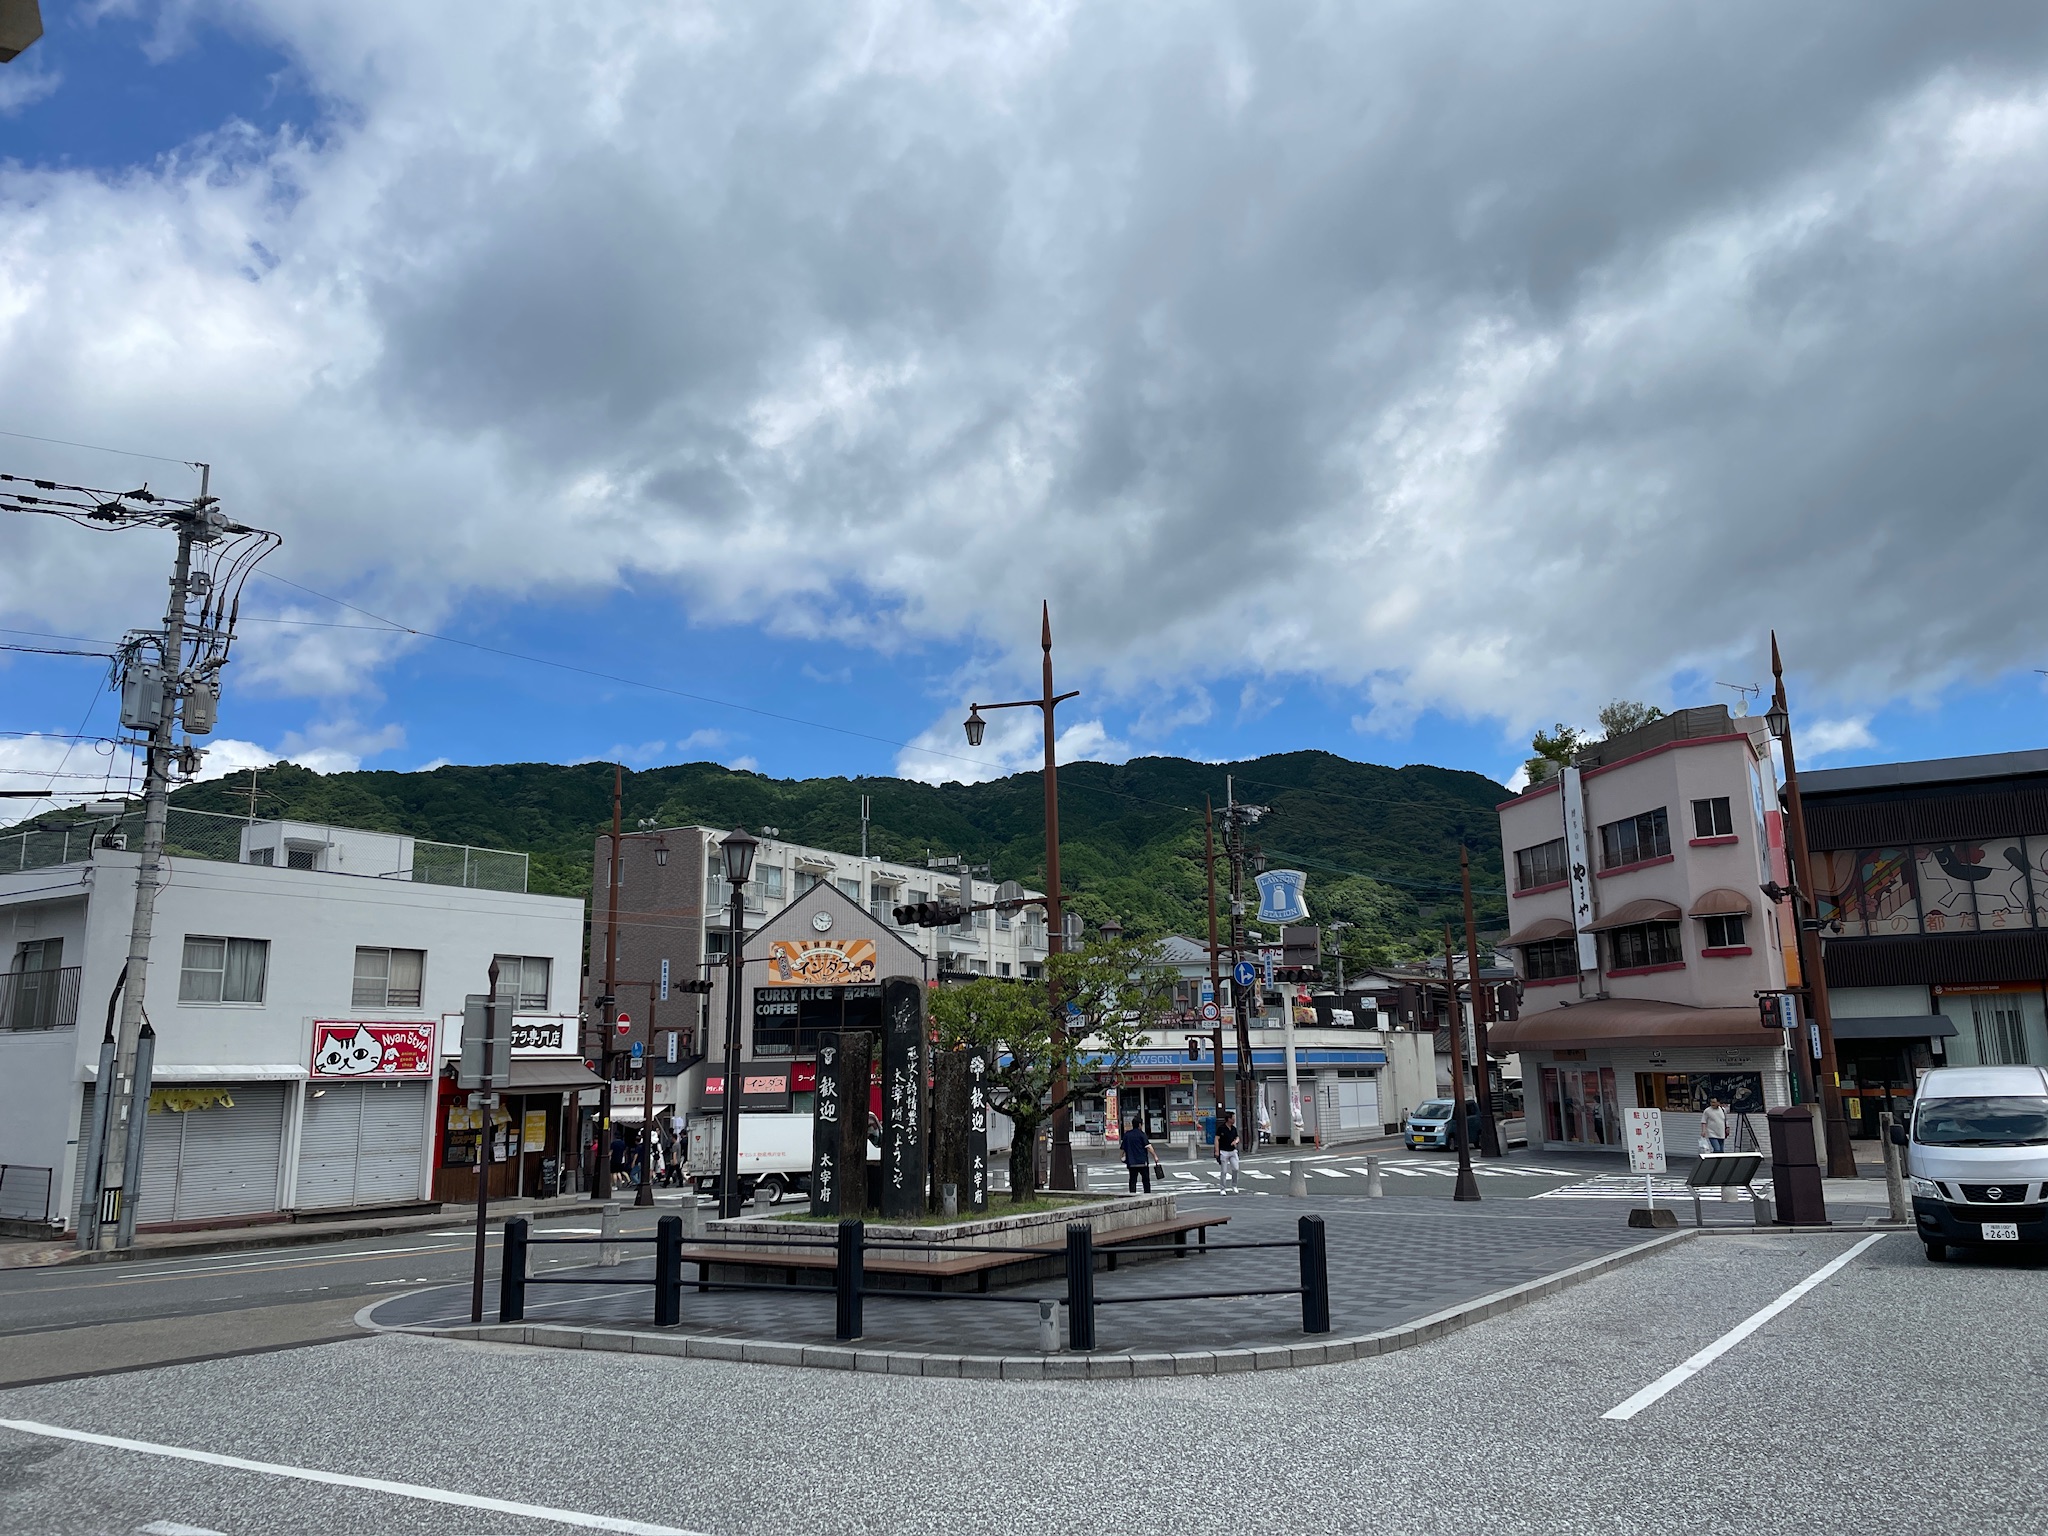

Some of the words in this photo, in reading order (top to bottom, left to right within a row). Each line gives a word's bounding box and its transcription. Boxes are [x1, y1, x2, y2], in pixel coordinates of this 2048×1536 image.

[1260, 875, 1297, 886] LAWSON
[1573, 861, 1589, 918] やまや
[1262, 907, 1298, 918] STATION
[792, 957, 851, 977] インダス
[757, 989, 797, 1002] CURRY
[801, 988, 833, 1000] RICE
[756, 1003, 798, 1015] COFFEE
[1205, 1007, 1216, 1016] 30
[381, 1033, 406, 1046] Nyan
[407, 1031, 428, 1053] Style
[746, 1077, 783, 1087] インダス
[818, 1075, 839, 1123] 歓迎
[969, 1086, 986, 1133] 歓迎
[1633, 1111, 1646, 1170] 駐車禁止
[1642, 1111, 1656, 1170] Uターン禁止
[1651, 1111, 1663, 1161] ロータリー内
[819, 1152, 834, 1203] 太宰府
[973, 1154, 984, 1204] 太宰府
[1990, 1230, 2016, 1239] 26-09
